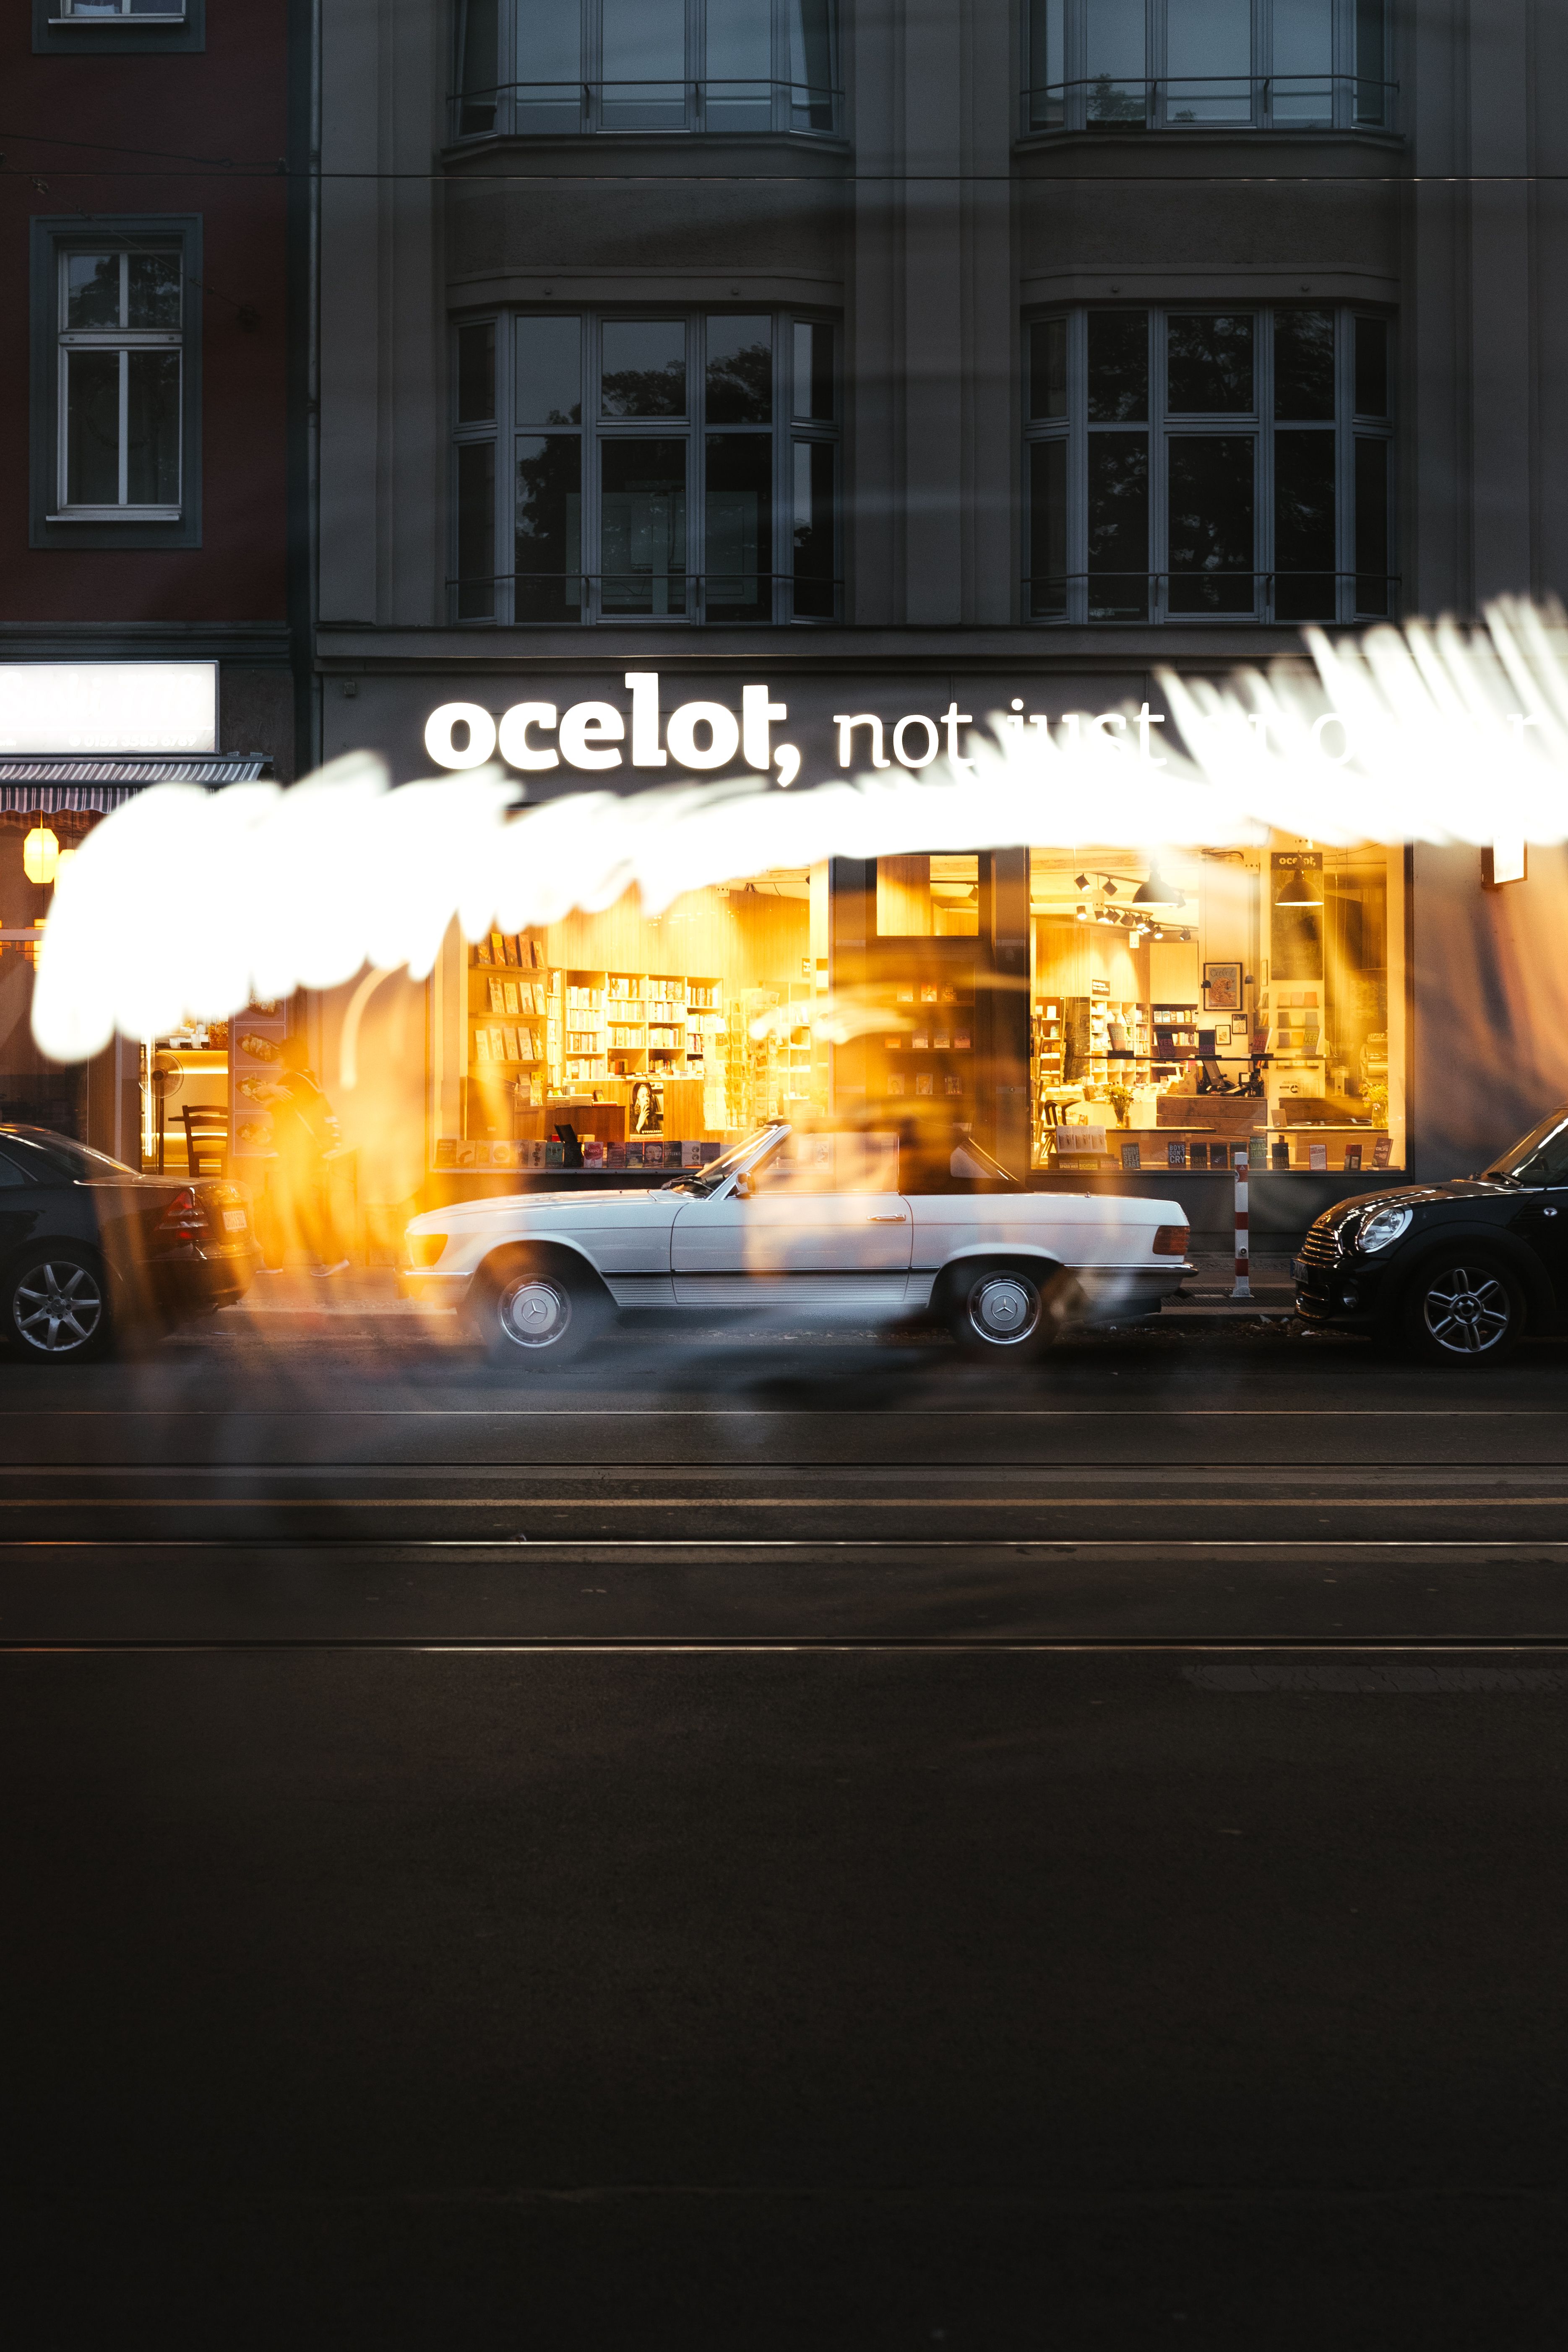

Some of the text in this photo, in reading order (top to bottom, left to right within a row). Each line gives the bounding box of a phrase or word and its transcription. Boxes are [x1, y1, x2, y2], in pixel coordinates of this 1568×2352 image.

[423, 672, 802, 789] ocelot,
[833, 701, 973, 769] not
[84, 735, 118, 747] 0152
[161, 734, 197, 747] 6789
[1279, 856, 1316, 867] oceot,
[1169, 1155, 1185, 1164] CRY
